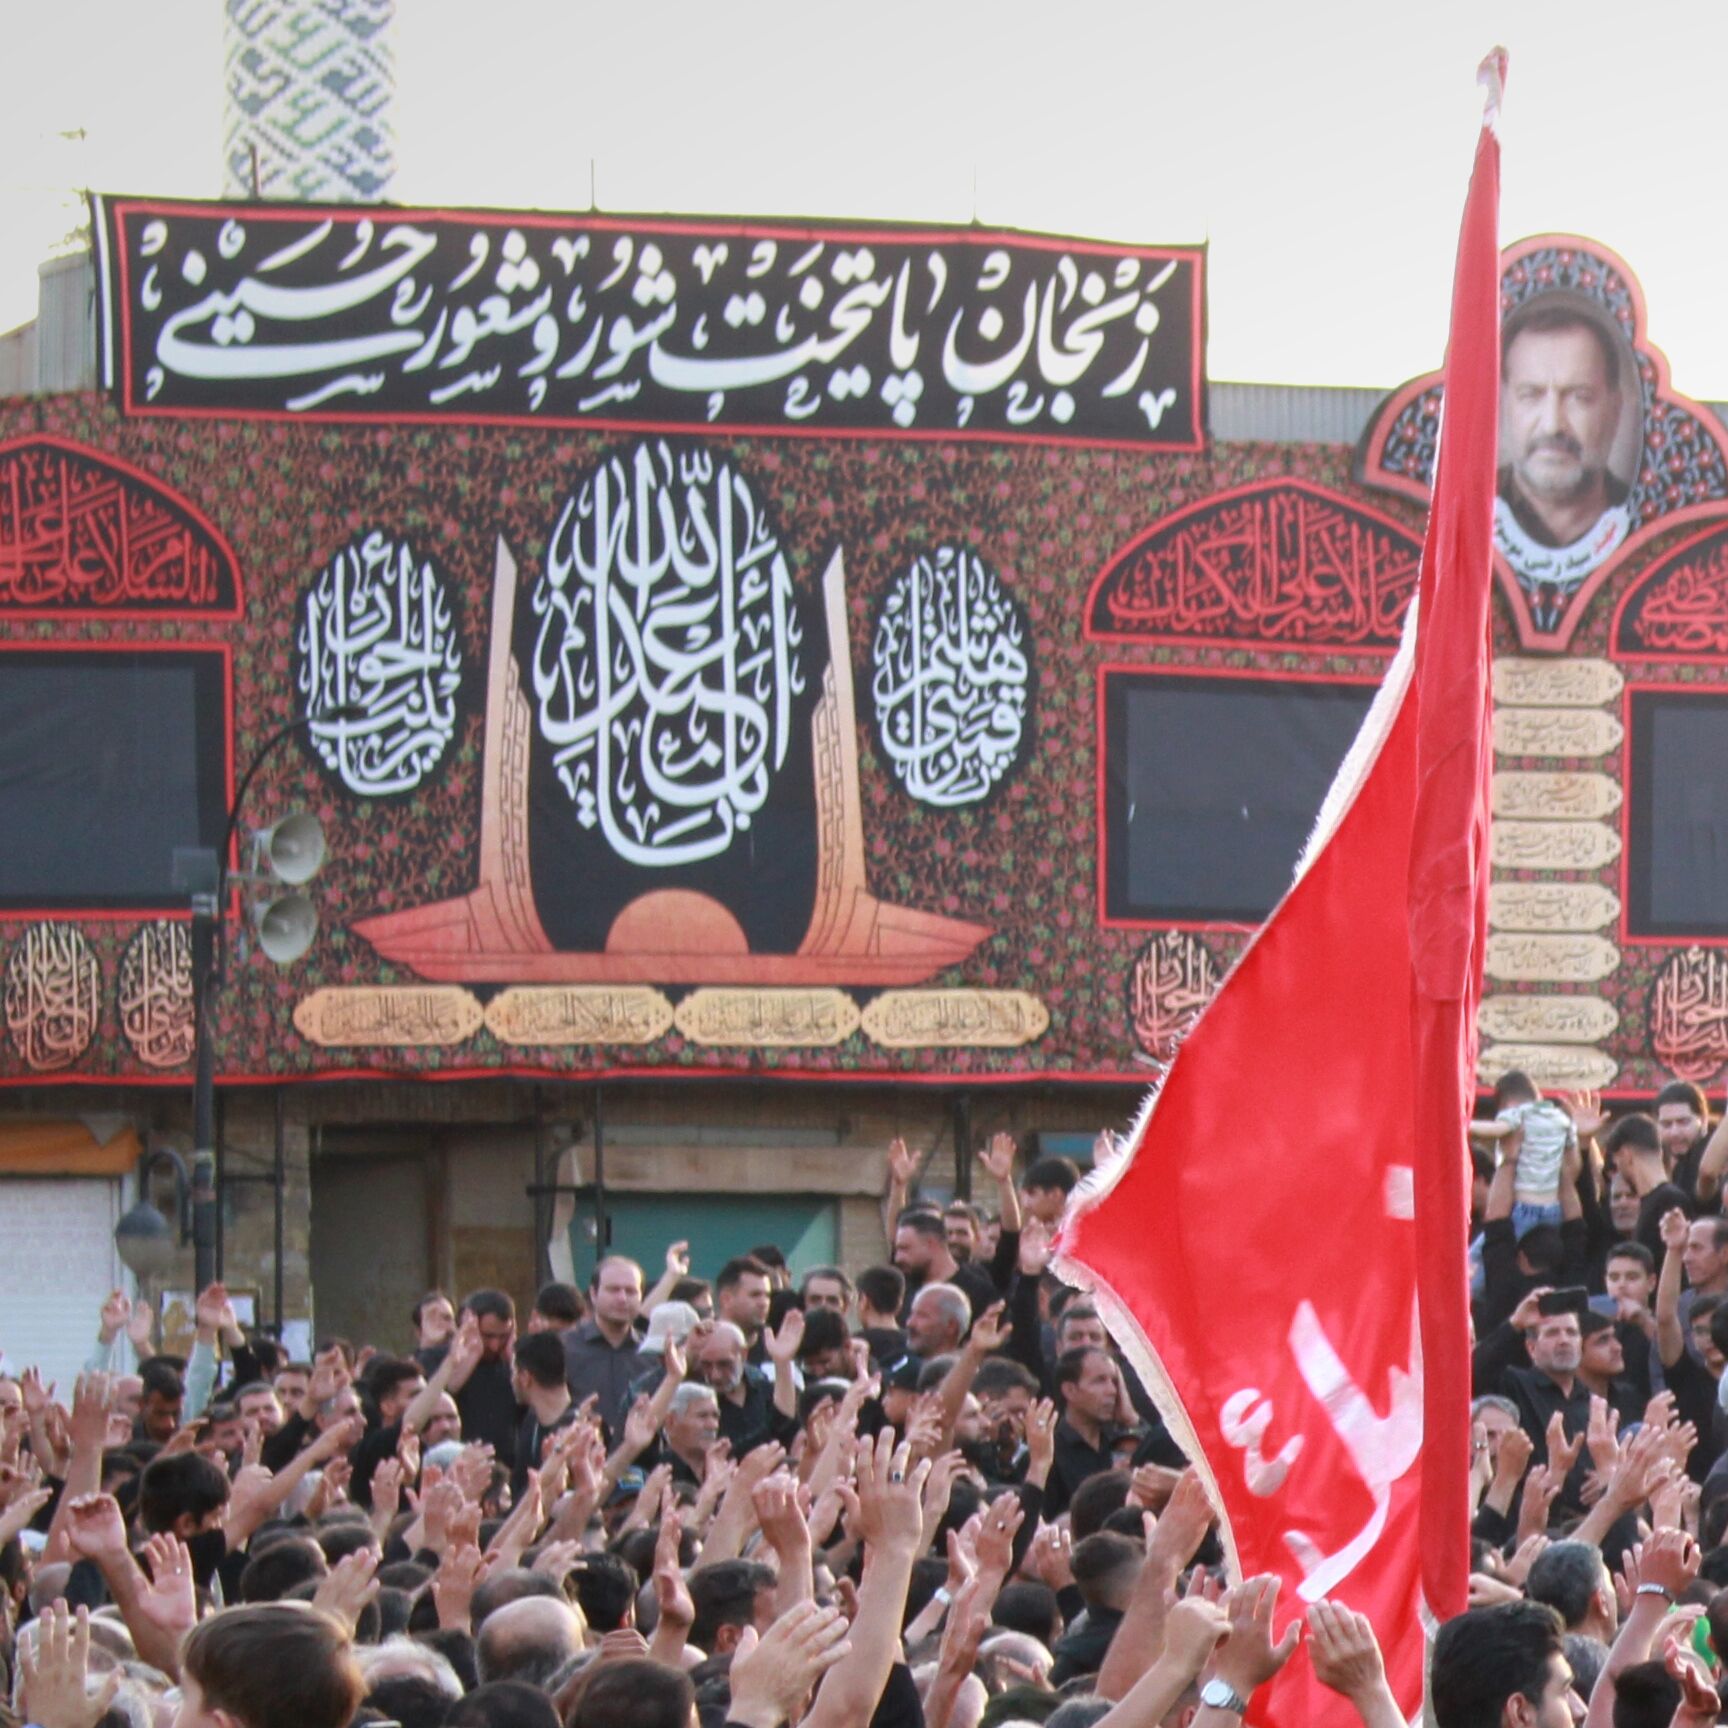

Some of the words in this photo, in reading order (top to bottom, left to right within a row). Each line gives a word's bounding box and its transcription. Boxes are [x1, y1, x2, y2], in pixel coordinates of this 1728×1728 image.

[156, 224, 438, 379] حسینی
[401, 229, 552, 373] شعور
[517, 312, 560, 377] و
[556, 242, 677, 380] شور
[649, 246, 924, 428] پایتخت
[942, 255, 1170, 426] زنجان
